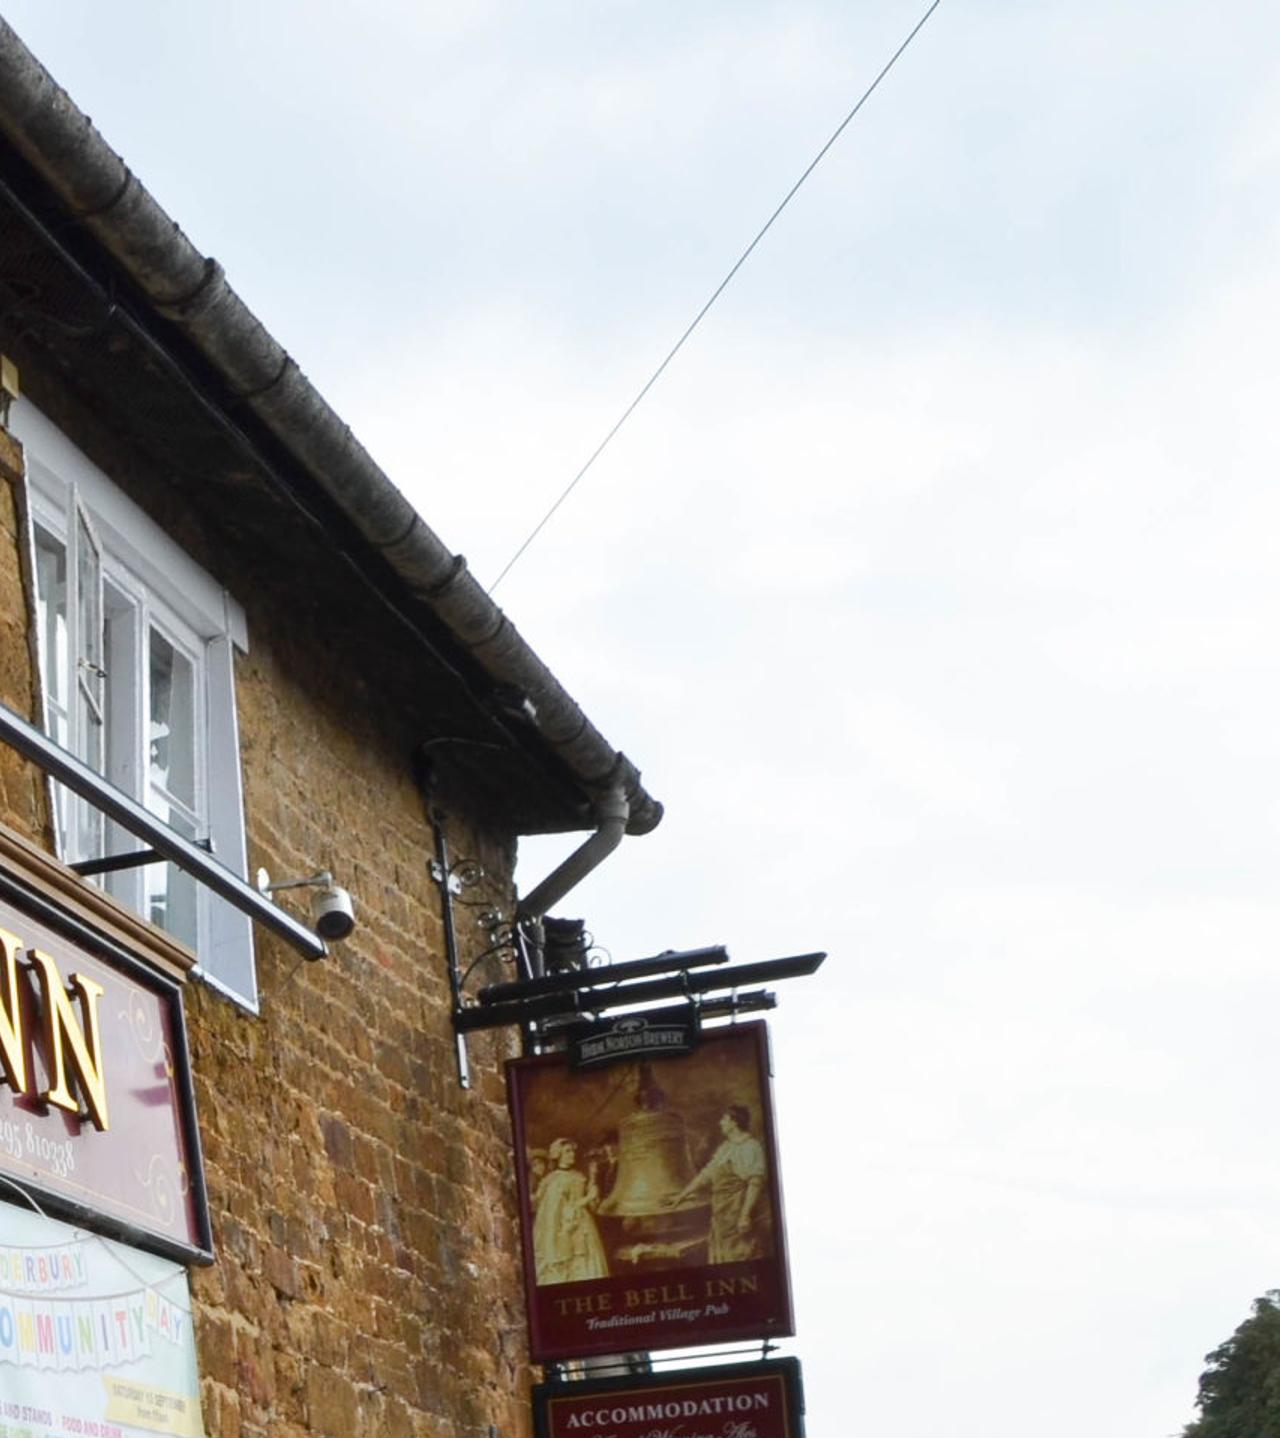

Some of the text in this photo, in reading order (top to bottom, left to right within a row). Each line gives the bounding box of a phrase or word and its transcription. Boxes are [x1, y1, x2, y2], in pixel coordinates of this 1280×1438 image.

[24, 1122, 77, 1178] 810338
[554, 1275, 761, 1317] THE BELL INN
[585, 1303, 730, 1331] Traditional Village Pub
[21, 1405, 53, 1427] STANDS
[61, 1414, 82, 1433] FOOD
[566, 1392, 770, 1430] ACCOMMODATION
